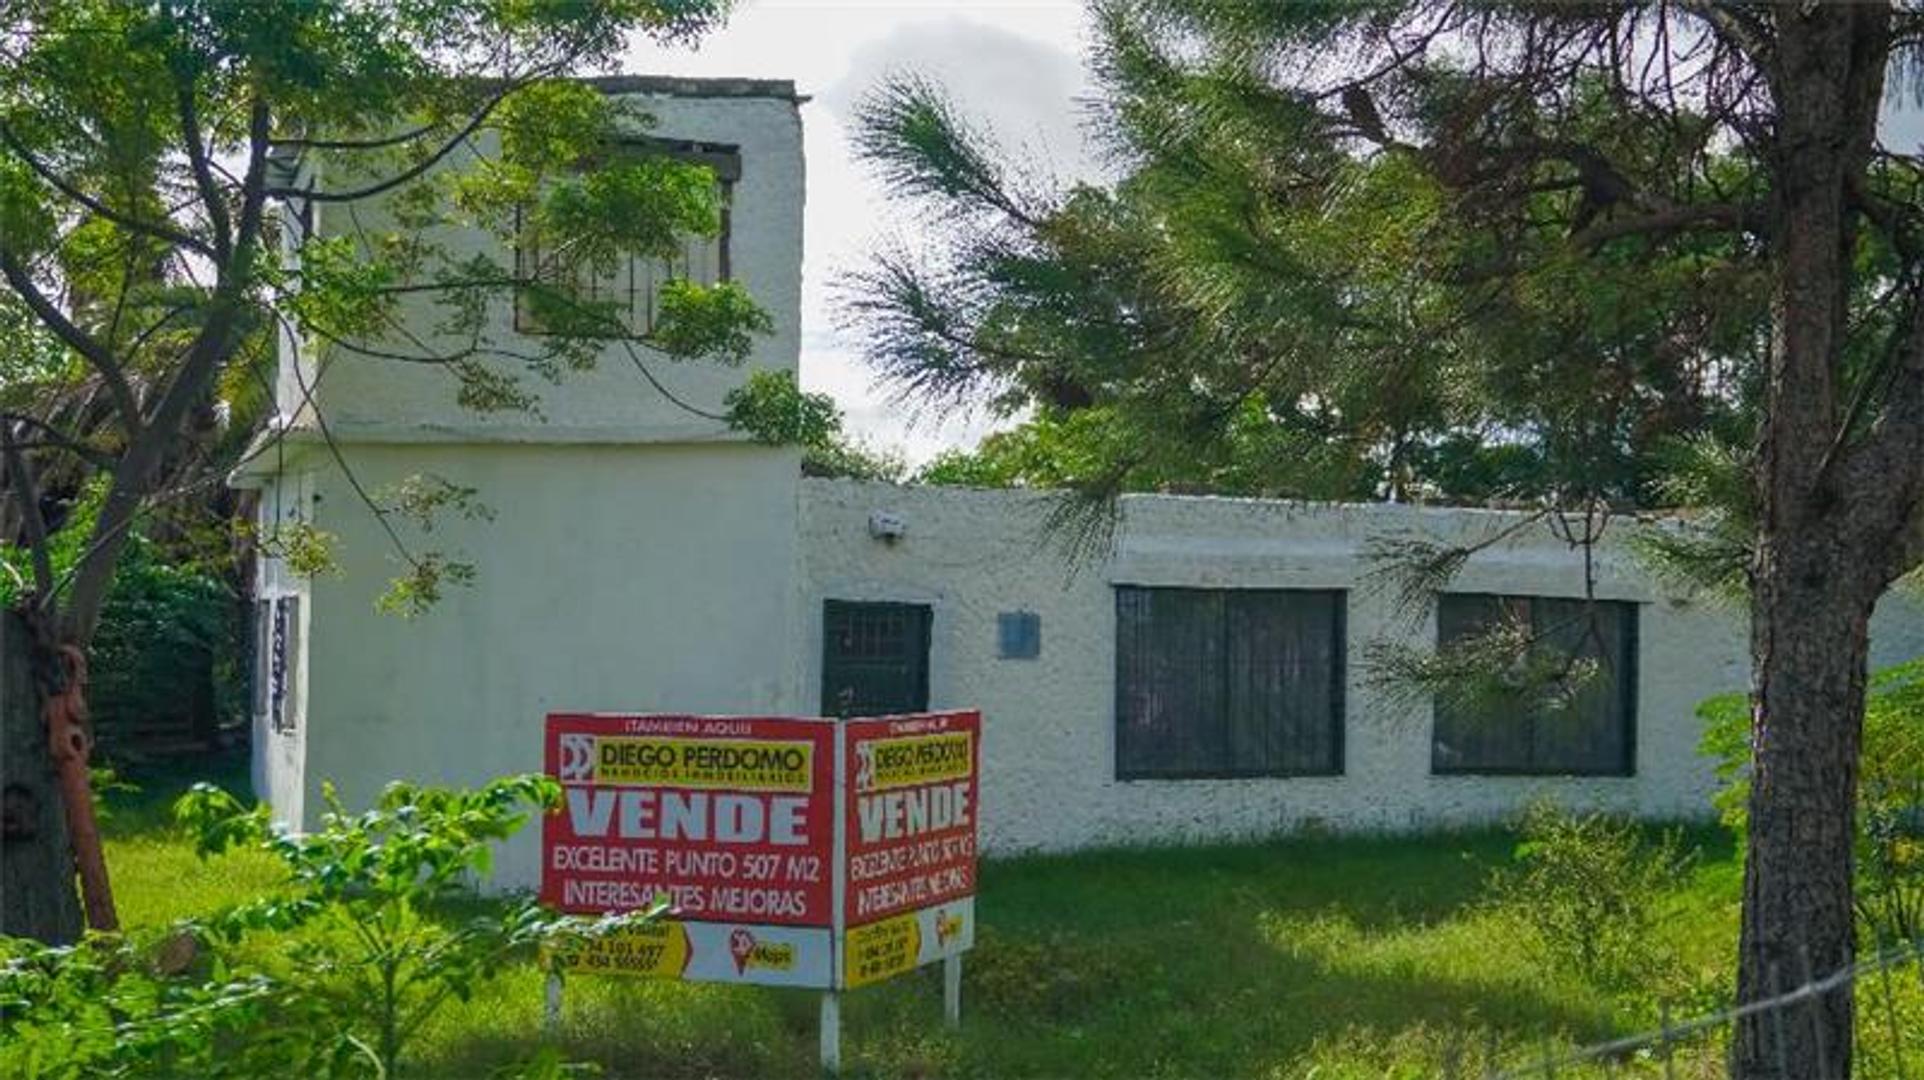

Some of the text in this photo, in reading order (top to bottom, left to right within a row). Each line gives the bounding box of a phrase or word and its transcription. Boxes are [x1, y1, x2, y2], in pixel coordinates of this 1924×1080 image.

[601, 744, 805, 771] DIEGO PERDOMO
[567, 788, 809, 845] VENDE
[857, 783, 969, 842] VENDE
[553, 845, 820, 882] EXCELENTE PUNTO 507 M2
[709, 885, 806, 915] MEJORAS
